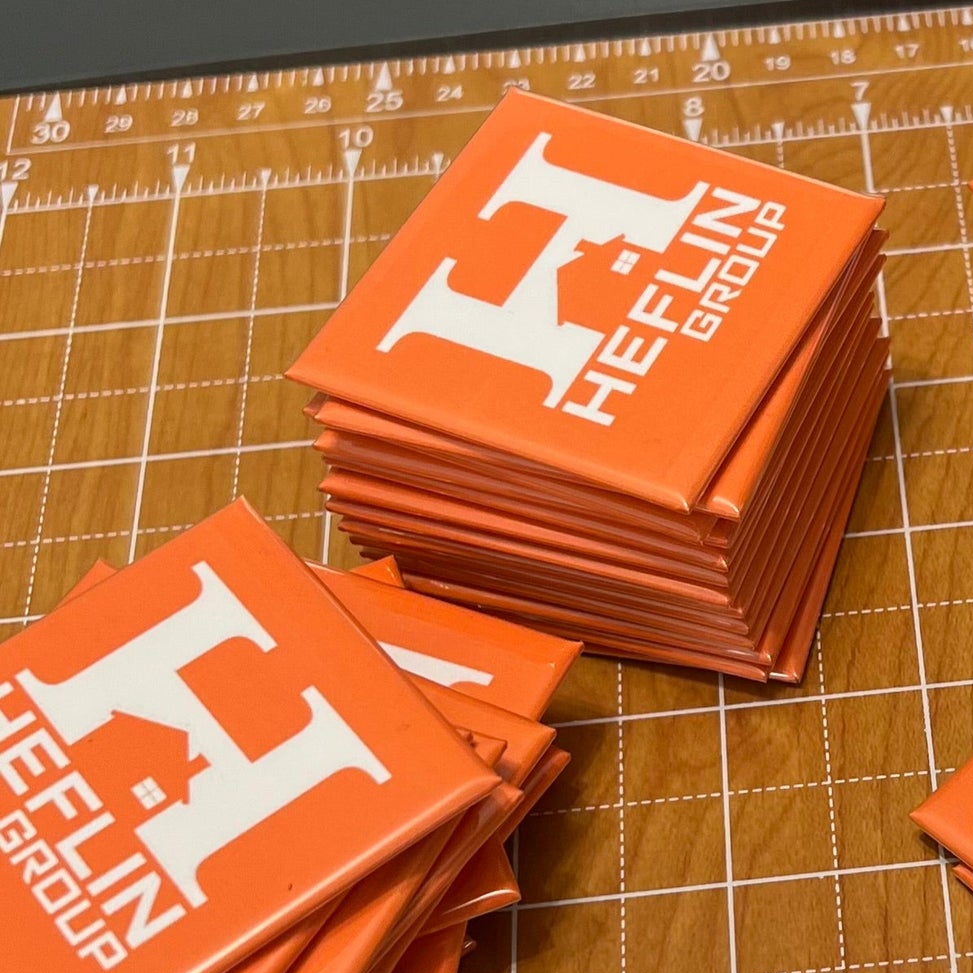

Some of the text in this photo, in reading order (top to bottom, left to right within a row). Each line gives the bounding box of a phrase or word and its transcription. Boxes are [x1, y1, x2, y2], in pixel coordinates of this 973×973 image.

[0, 158, 32, 181] 12
[167, 141, 197, 164] 11
[339, 125, 374, 148] 10
[683, 96, 705, 118] 8
[851, 81, 871, 101] 7
[30, 120, 71, 144] 30
[104, 114, 133, 133] 29
[170, 108, 199, 127] 28
[237, 102, 266, 121] 27
[365, 90, 404, 112] 25
[436, 85, 464, 102] 24
[568, 73, 597, 90] 22
[633, 68, 660, 84] 21
[692, 60, 731, 83] 20
[764, 55, 792, 71] 19
[830, 49, 857, 65] 18
[895, 43, 920, 58] 17
[562, 187, 761, 427] HEFLIN
[680, 201, 786, 342] GROUP
[0, 809, 128, 970] GROUP
